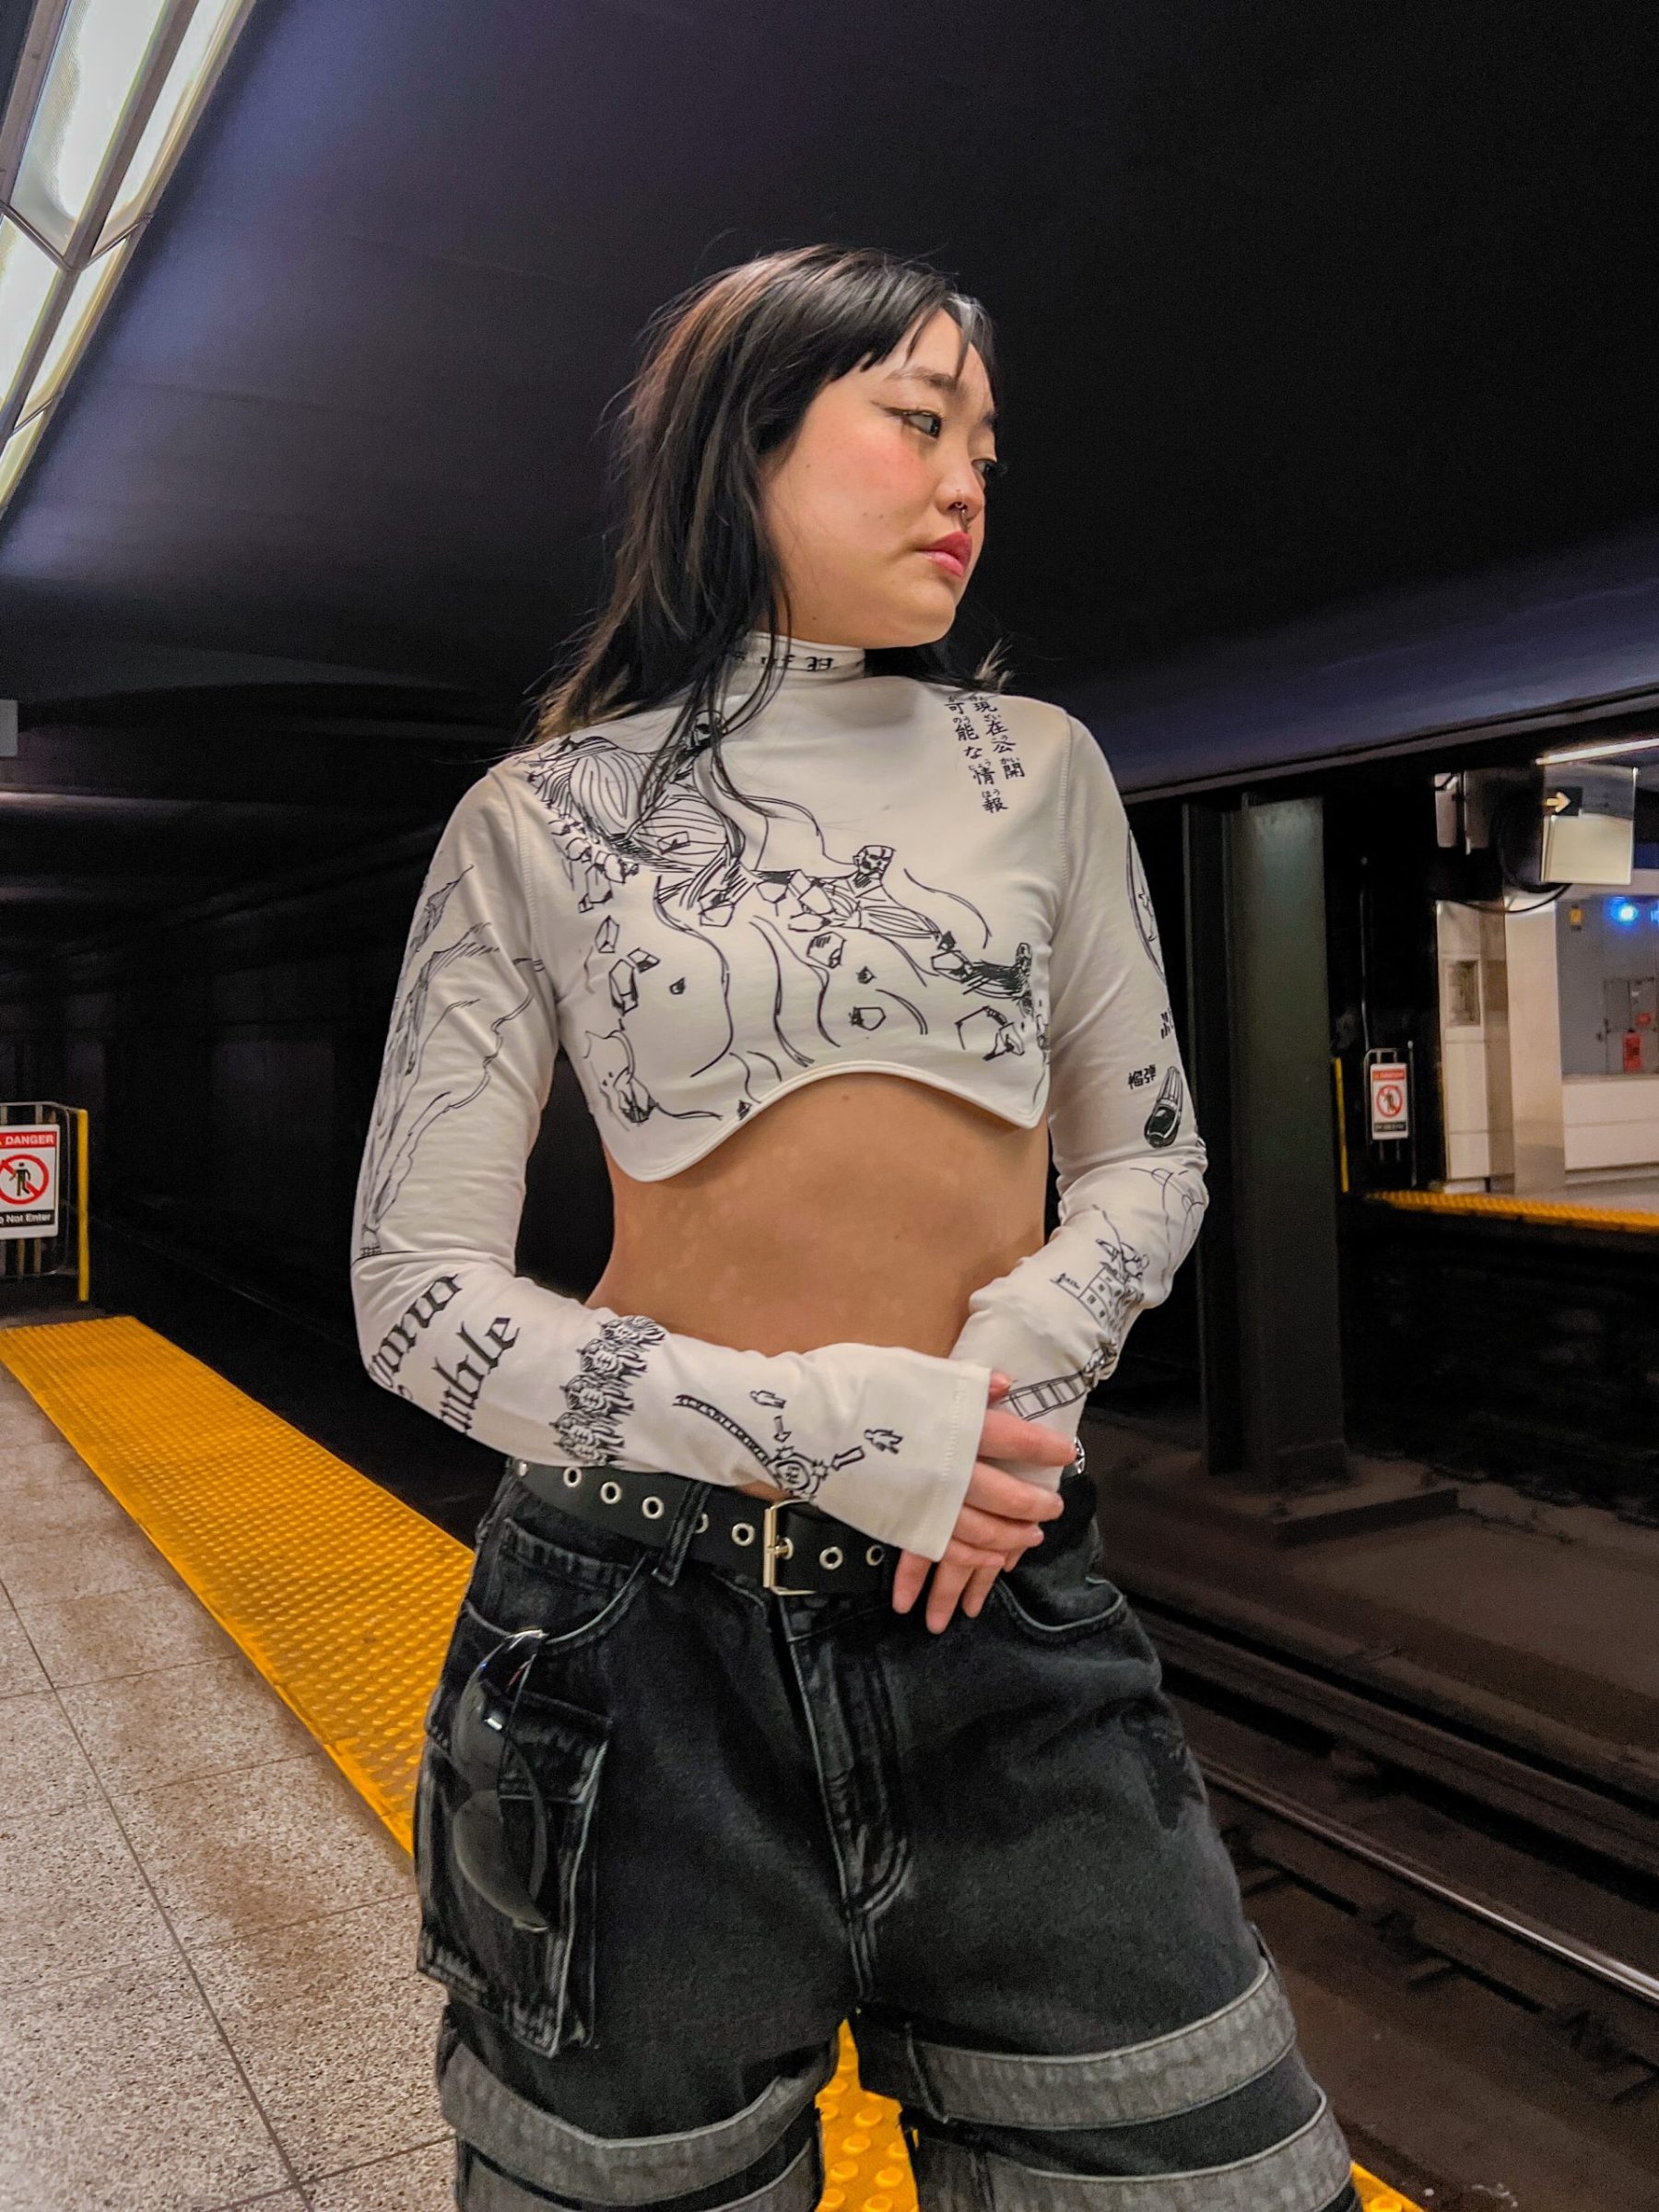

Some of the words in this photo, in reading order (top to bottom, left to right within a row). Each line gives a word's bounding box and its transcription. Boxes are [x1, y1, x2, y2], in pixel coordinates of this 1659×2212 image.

[6, 1134, 54, 1146] DANGER
[6, 1214, 24, 1223] Not
[25, 1212, 52, 1222] Enter
